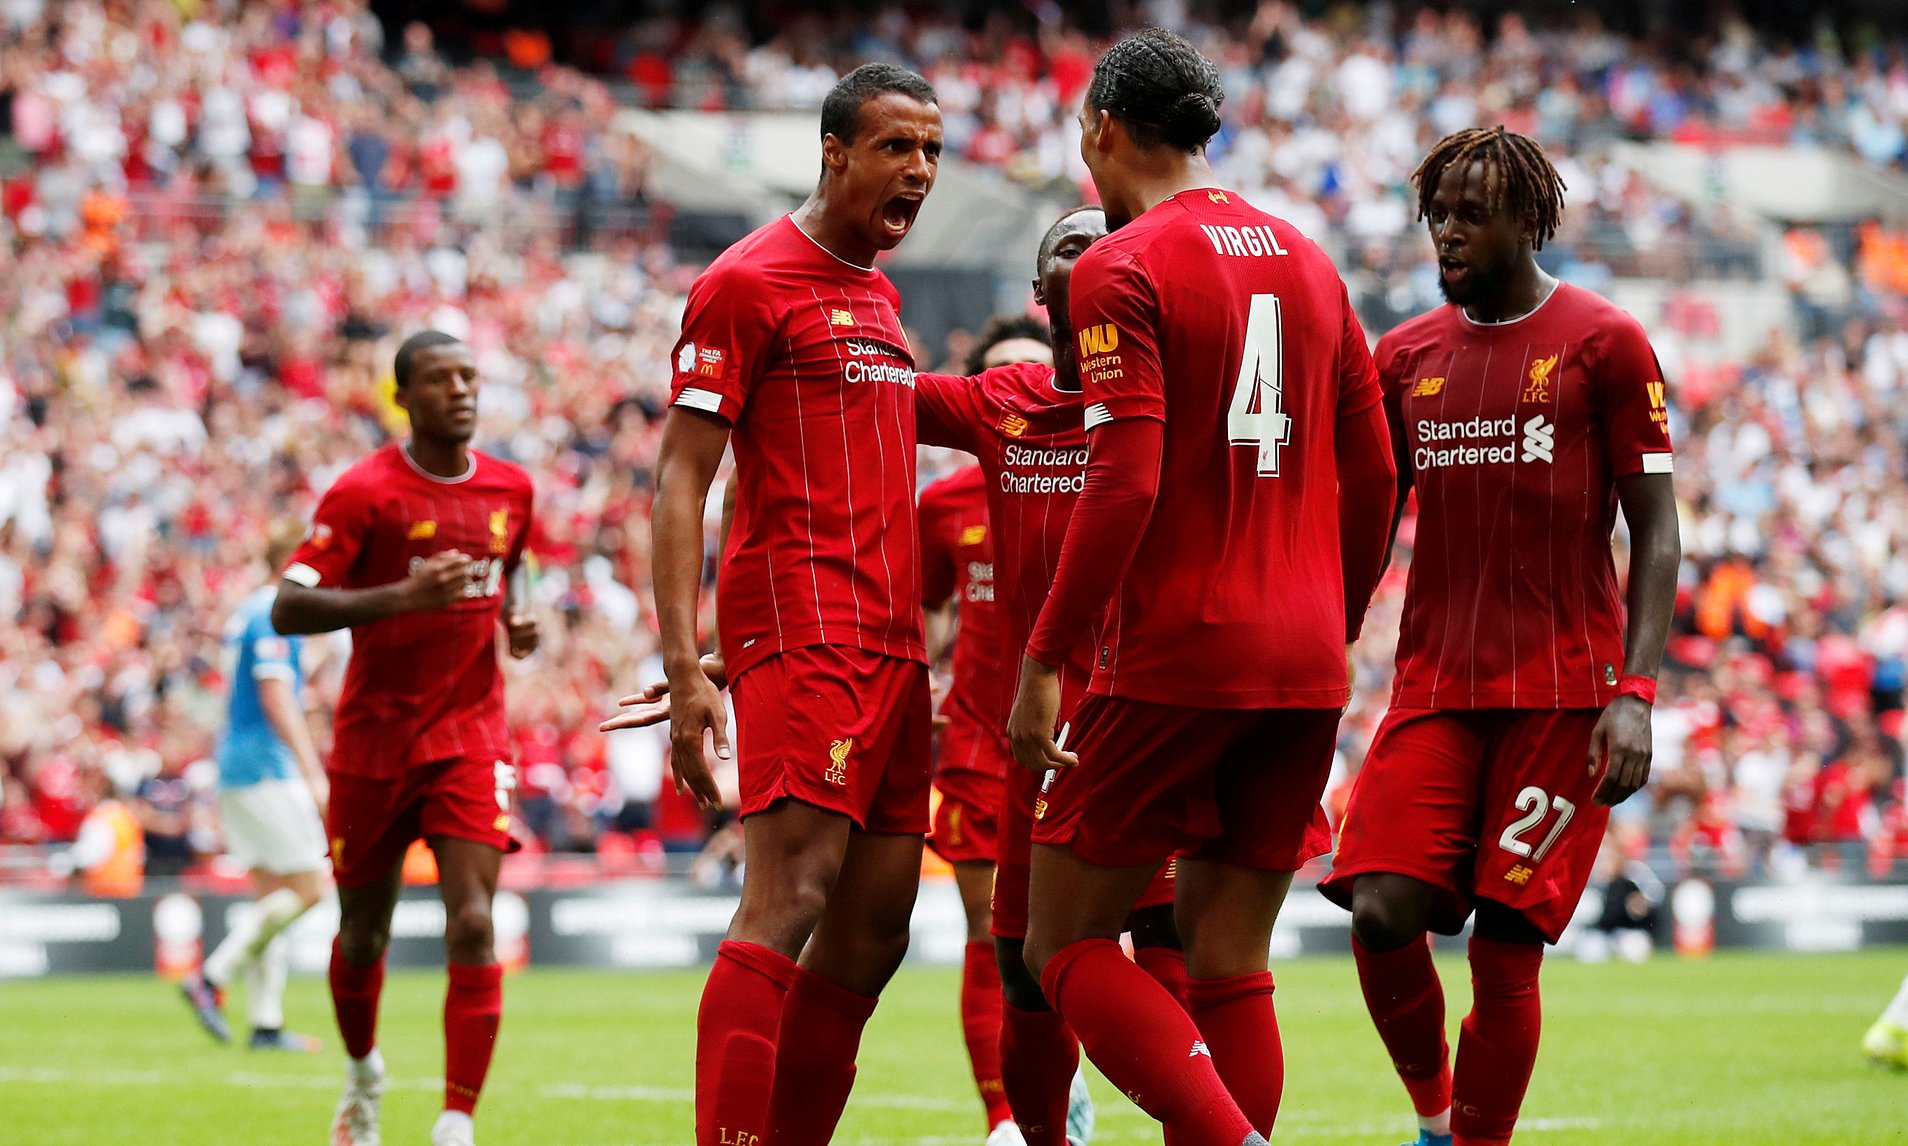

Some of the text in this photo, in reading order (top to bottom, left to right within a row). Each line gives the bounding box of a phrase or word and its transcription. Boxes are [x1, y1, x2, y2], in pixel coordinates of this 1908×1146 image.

[1199, 224, 1289, 256] VIRGIL
[845, 361, 912, 388] Chartered
[1081, 355, 1122, 374] Western
[1091, 367, 1124, 384] Union
[1227, 293, 1292, 477] 4
[1418, 414, 1516, 443] Standard
[1005, 444, 1090, 466] Standard
[1415, 441, 1516, 470] Chartered
[1000, 470, 1086, 494] Chartered
[1499, 785, 1576, 863] 27
